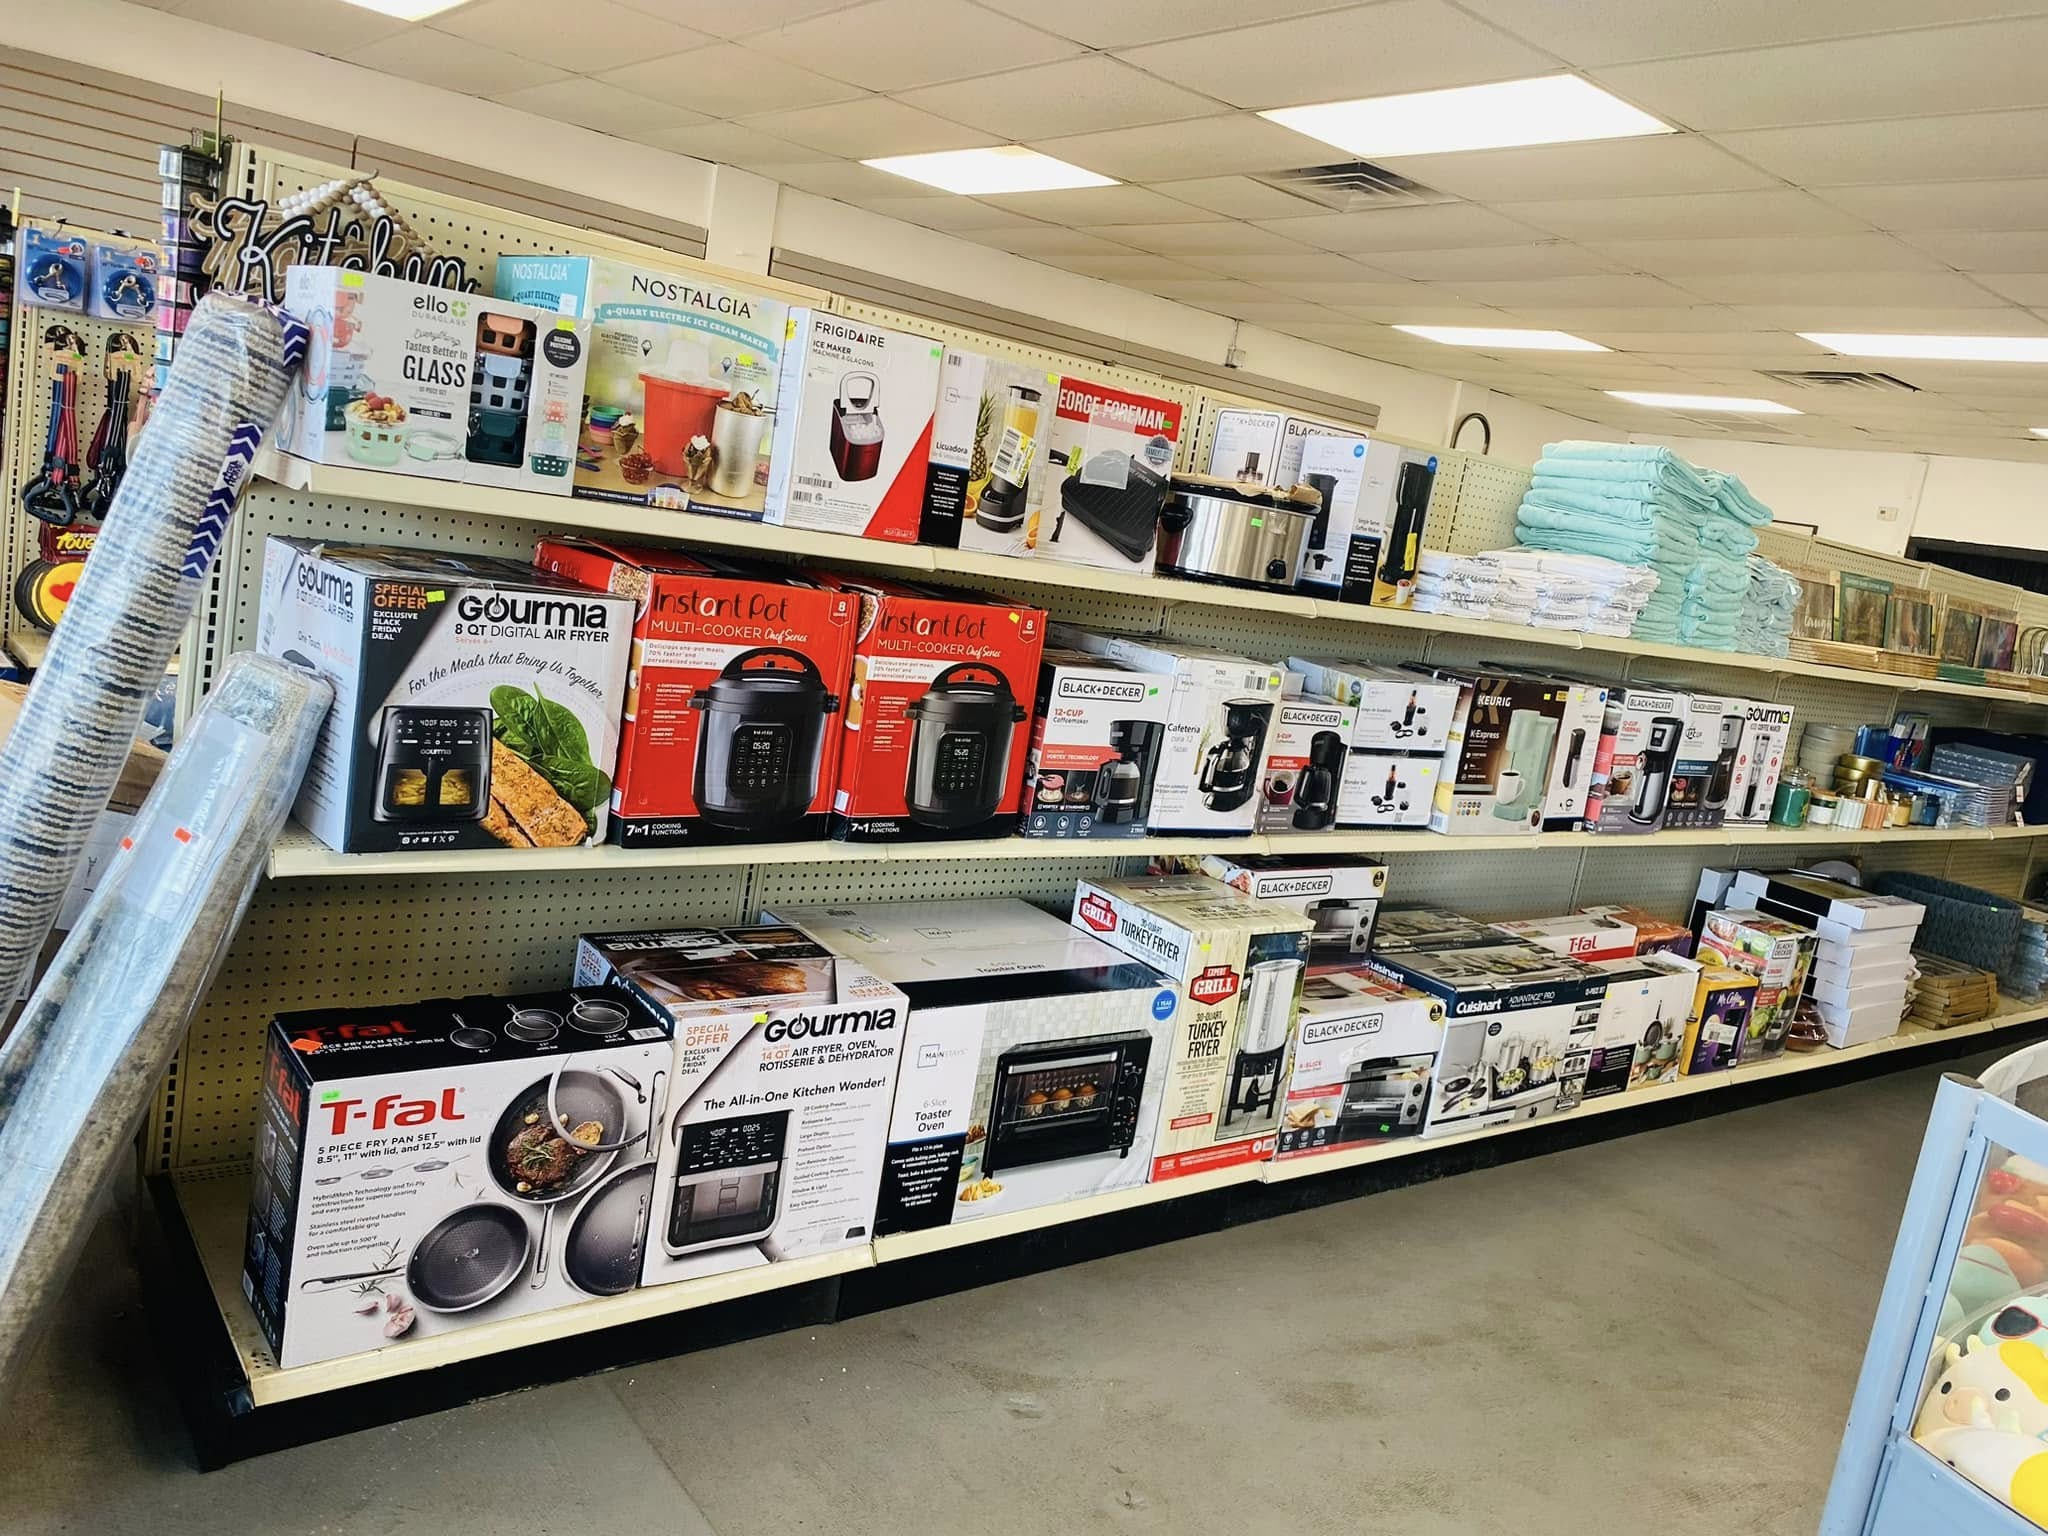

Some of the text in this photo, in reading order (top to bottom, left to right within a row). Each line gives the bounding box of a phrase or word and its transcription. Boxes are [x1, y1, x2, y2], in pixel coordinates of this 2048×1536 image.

[512, 263, 568, 281] NOSTALGIA
[413, 294, 448, 314] ello
[631, 275, 752, 319] NOSTALGIA
[412, 310, 467, 327] DURAGLASS
[606, 307, 769, 350] 4-QUART ELECTRIC ICE CREAM MAKER
[815, 321, 885, 348] FRIGIDAIRE
[405, 340, 468, 360] Tastes Better In
[812, 348, 840, 360] MACHINE
[813, 340, 852, 354] ICE MAKER
[403, 355, 466, 388] GLASS
[1103, 398, 1165, 430] FOREMAN
[936, 441, 968, 454] Licuadora
[298, 562, 353, 609] Gourmia
[374, 583, 427, 598] SPECIAL
[374, 594, 428, 610] OFFER
[458, 592, 607, 629] Gourmia
[653, 584, 788, 622] Instant Pot
[837, 601, 846, 611] 8
[372, 618, 401, 627] BLACK
[373, 610, 418, 620] EXCLUSIVE
[372, 625, 402, 635] FRIDAY
[651, 619, 808, 644] MULTI-COOKER Chef Series
[881, 610, 987, 639] Instant Pot
[1026, 620, 1033, 629] 8
[371, 632, 395, 641] DEAL
[454, 624, 609, 643] 8 QT DIGITAL AIR FRYER
[649, 642, 725, 655] Delicious one-pot meals,
[877, 639, 1001, 660] MULTI-COOKER Chef Series
[408, 652, 604, 699] For the Meals that Bring Us Together
[1062, 683, 1141, 697] BLACK+DECKER
[1478, 695, 1512, 707] KEURIG
[1629, 698, 1672, 710] BLACK+DECKER
[1053, 716, 1089, 725] Coffeemaker
[1054, 708, 1084, 717] 12-CUP
[1283, 711, 1338, 723] BLACK+DECKER
[1746, 706, 1790, 724] Gourmia
[1470, 729, 1500, 740] K-Express
[1260, 880, 1329, 894] BLACK+DECKER
[1082, 903, 1113, 926] GRILL
[1141, 919, 1162, 932] 30-QUART
[1121, 918, 1179, 962] TURKEY FRYER
[1569, 935, 1597, 952] T-fal
[977, 963, 1045, 973] Toaster Oven
[1207, 968, 1226, 977] EXPERT
[1193, 978, 1234, 996] GRILL
[1509, 993, 1541, 1004] ADVANTAGE
[1543, 991, 1555, 1000] PRO
[1456, 998, 1502, 1015] Cuisinart
[1196, 1011, 1222, 1021] 30-QUART
[293, 1020, 416, 1042] T-fal
[687, 1023, 730, 1036] SPECIAL
[765, 1008, 896, 1042] Gourmia
[1188, 1021, 1227, 1041] TURKEY
[1307, 1018, 1379, 1039] BLACK+DECKER
[685, 1033, 729, 1047] OFFER
[1188, 1039, 1220, 1058] FRYER
[683, 1055, 706, 1063] BLACK
[684, 1046, 720, 1056] EXCLUSIVE
[761, 1040, 877, 1061] 14 QT AIR FRYER, OVEN,
[682, 1060, 707, 1069] FRIDAY
[759, 1048, 894, 1072] ROTISSERIE & DEHYDRATOR
[682, 1067, 700, 1075] DEAL
[704, 1077, 886, 1111] The All-in-One Kitchen Wonder!
[320, 1087, 465, 1136] T-fal
[923, 1099, 947, 1109] 6-Slice
[914, 1108, 952, 1122] Toaster
[918, 1121, 945, 1133] Oven
[318, 1132, 438, 1155] 5 PIECE FRY PAN SET
[360, 1147, 382, 1159] with
[383, 1146, 399, 1157] lid,
[401, 1143, 420, 1154] and
[447, 1137, 468, 1147] with
[470, 1134, 482, 1144] lid
[311, 1197, 354, 1209] construction
[365, 1191, 394, 1202] superior
[395, 1188, 417, 1198] searing
[312, 1191, 353, 1201] HybridMesh
[354, 1186, 392, 1196] Technology
[405, 1180, 425, 1189] Tri-Ply
